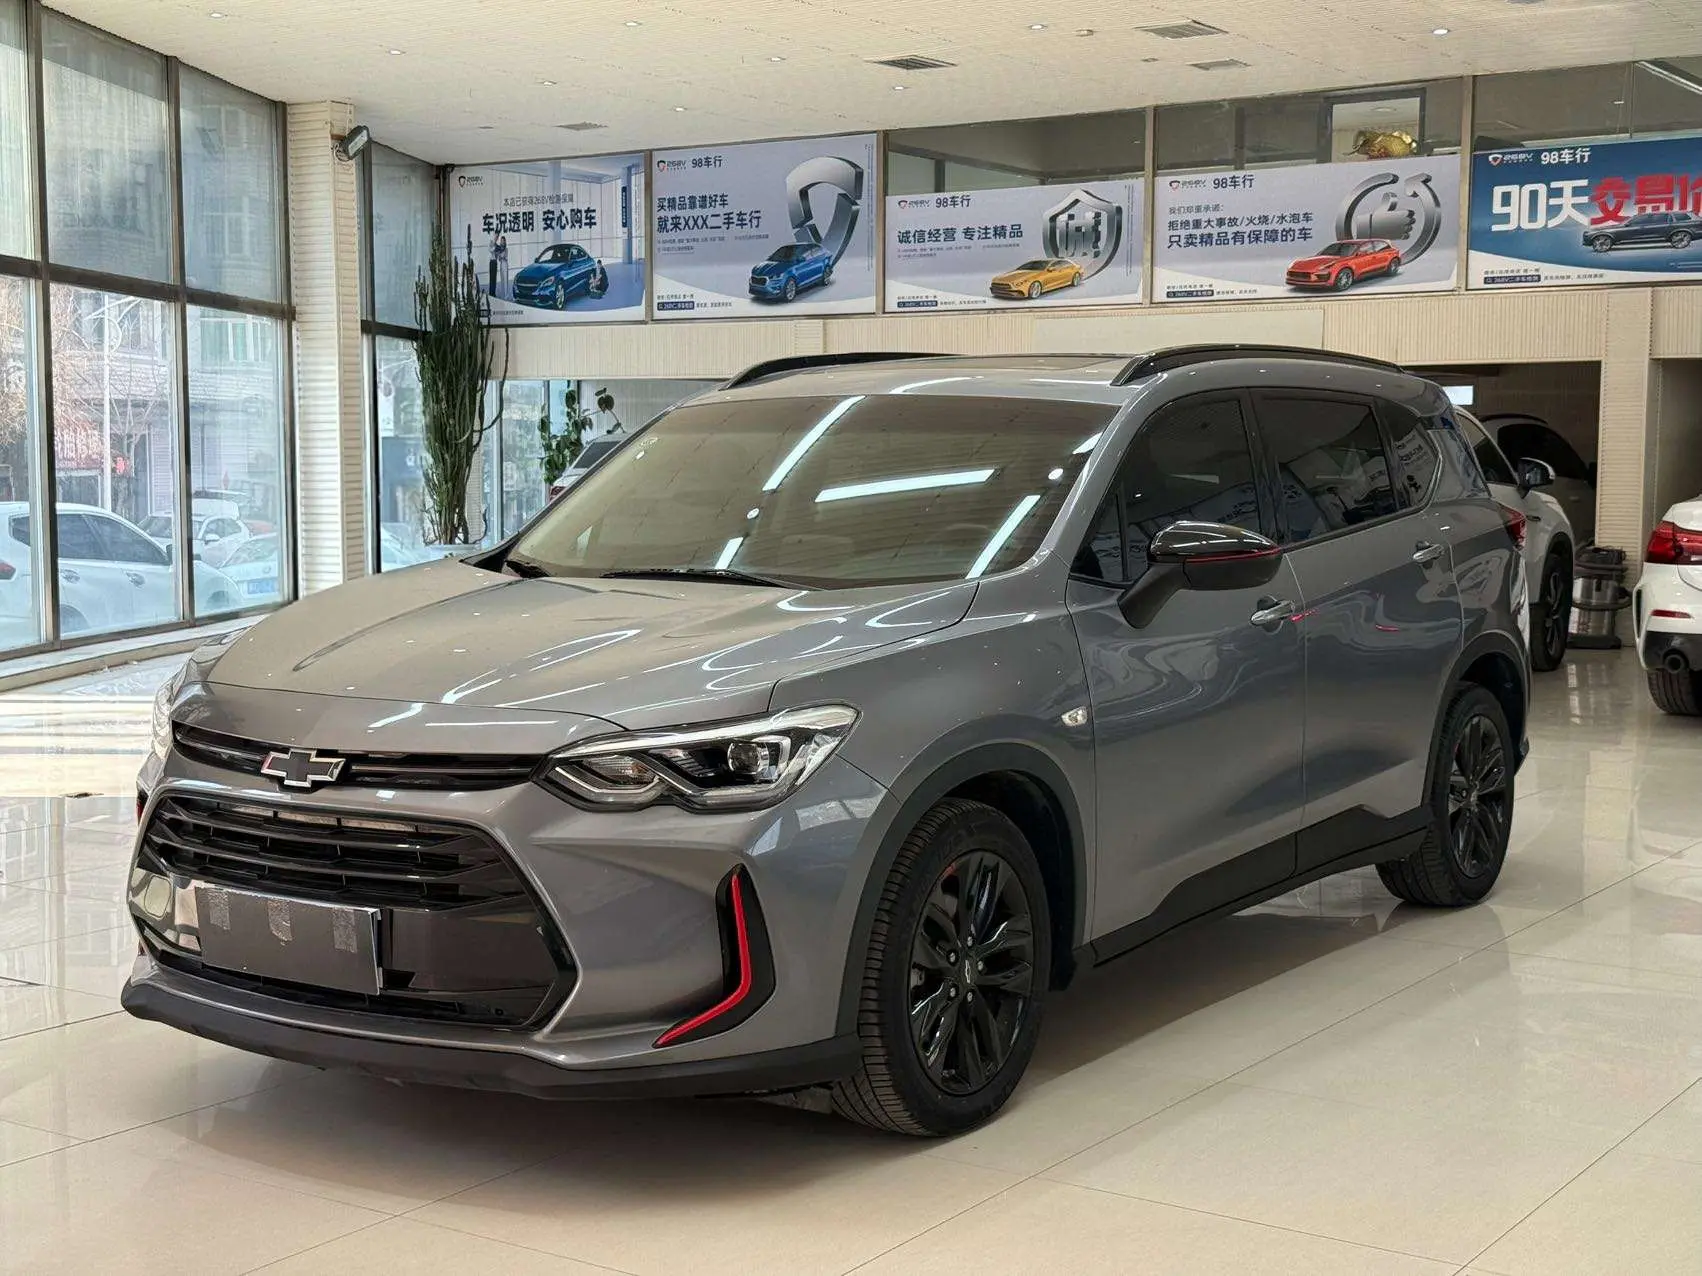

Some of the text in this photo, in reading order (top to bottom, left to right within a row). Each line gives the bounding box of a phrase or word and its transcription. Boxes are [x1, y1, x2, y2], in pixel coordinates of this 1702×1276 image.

[691, 156, 722, 169] 98车行
[1541, 147, 1592, 165] 98车行
[1213, 174, 1254, 190] 98车行
[657, 193, 729, 212] 买精品靠谱好车
[935, 194, 971, 208] 98车行
[482, 207, 597, 235] 车况透明 安心购车
[657, 210, 761, 233] 就来XXX二手车行
[1168, 212, 1313, 231] 拒绝重大事故/火烧/水泡车
[897, 223, 1023, 244] 诚信经营 专注精品
[1167, 227, 1313, 249] 只卖精品有保障的车
